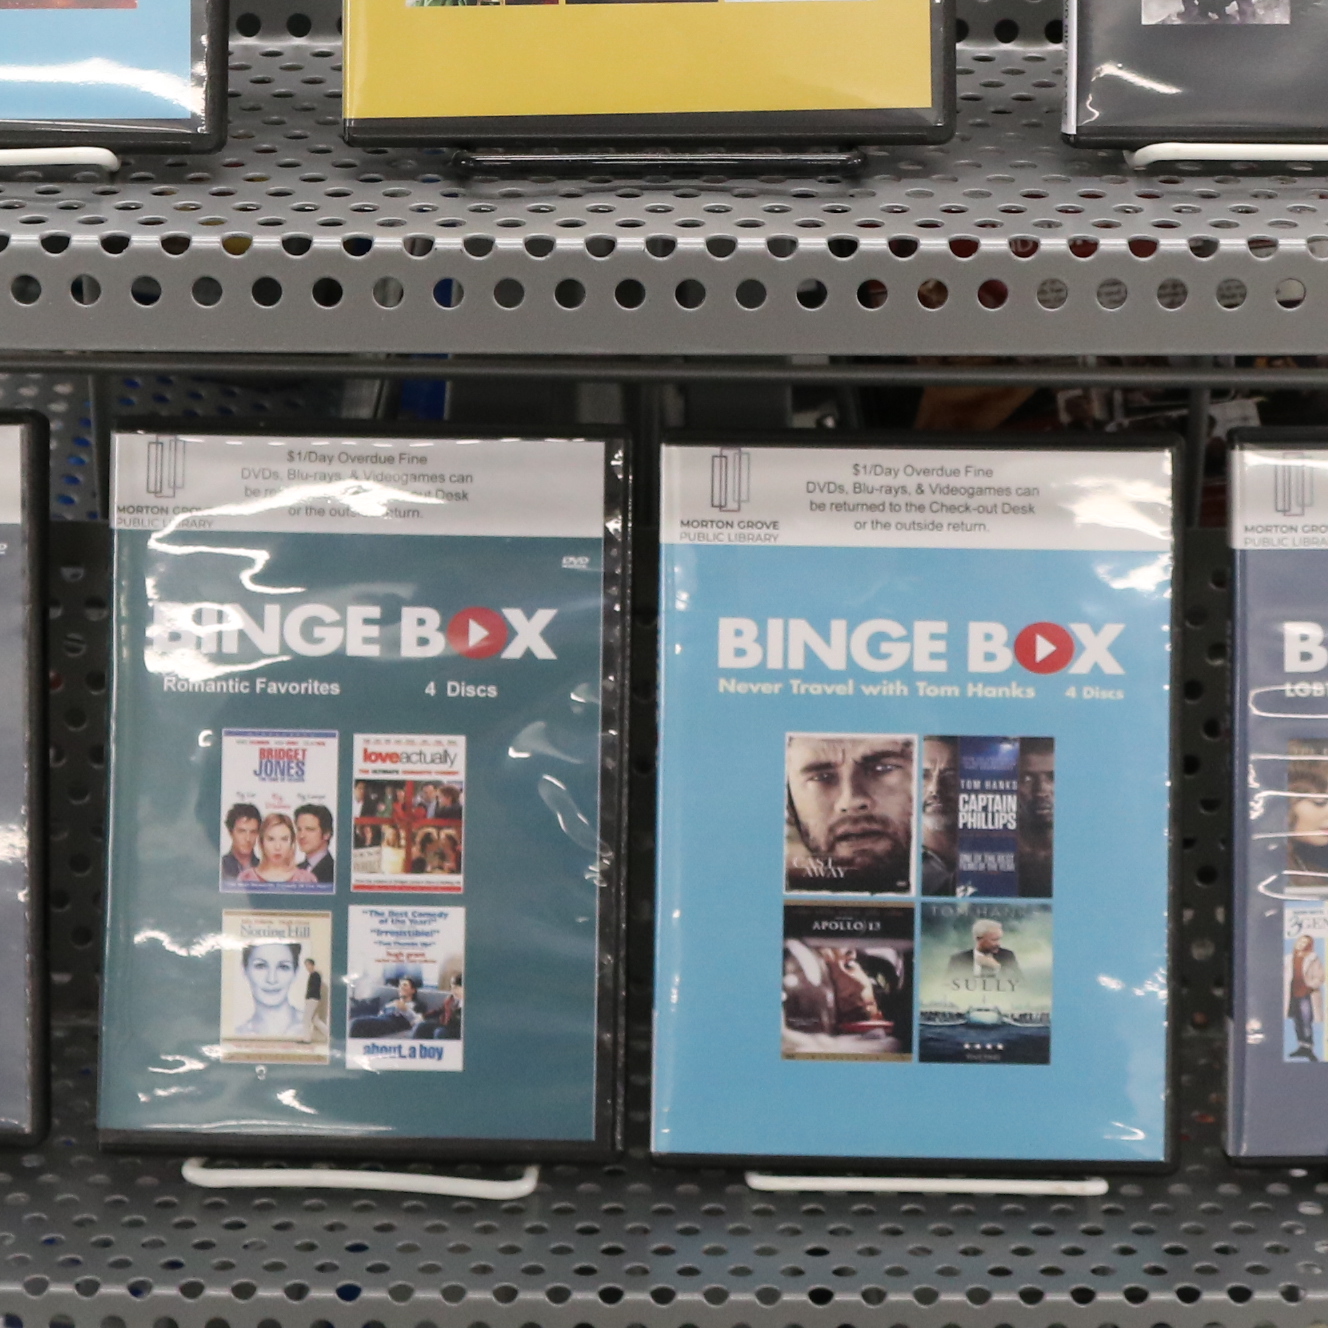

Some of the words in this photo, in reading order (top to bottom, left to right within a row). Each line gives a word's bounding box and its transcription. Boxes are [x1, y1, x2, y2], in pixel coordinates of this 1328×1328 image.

[151, 603, 380, 656] BINGE
[401, 606, 558, 660] BOX
[718, 618, 947, 672] BINGE
[968, 621, 1126, 674] BOX
[163, 677, 250, 693] Romantic
[256, 678, 340, 696] Favorites
[425, 682, 435, 697] 4
[447, 682, 497, 698] Discs
[719, 678, 782, 695] Never
[790, 679, 854, 696] Travel
[861, 679, 907, 697] with
[916, 682, 958, 697] Tom
[967, 682, 1035, 698] Hanks
[1065, 686, 1077, 698] 4
[1083, 686, 1124, 699] Discs
[260, 748, 307, 760] BRIDGET
[254, 760, 305, 776] JONES
[961, 780, 981, 790] TOM
[984, 779, 1017, 790] HANKS
[959, 794, 1017, 811] CAPTAIN
[959, 812, 1016, 830] PHILLIPS
[951, 979, 1018, 991] SULLY
